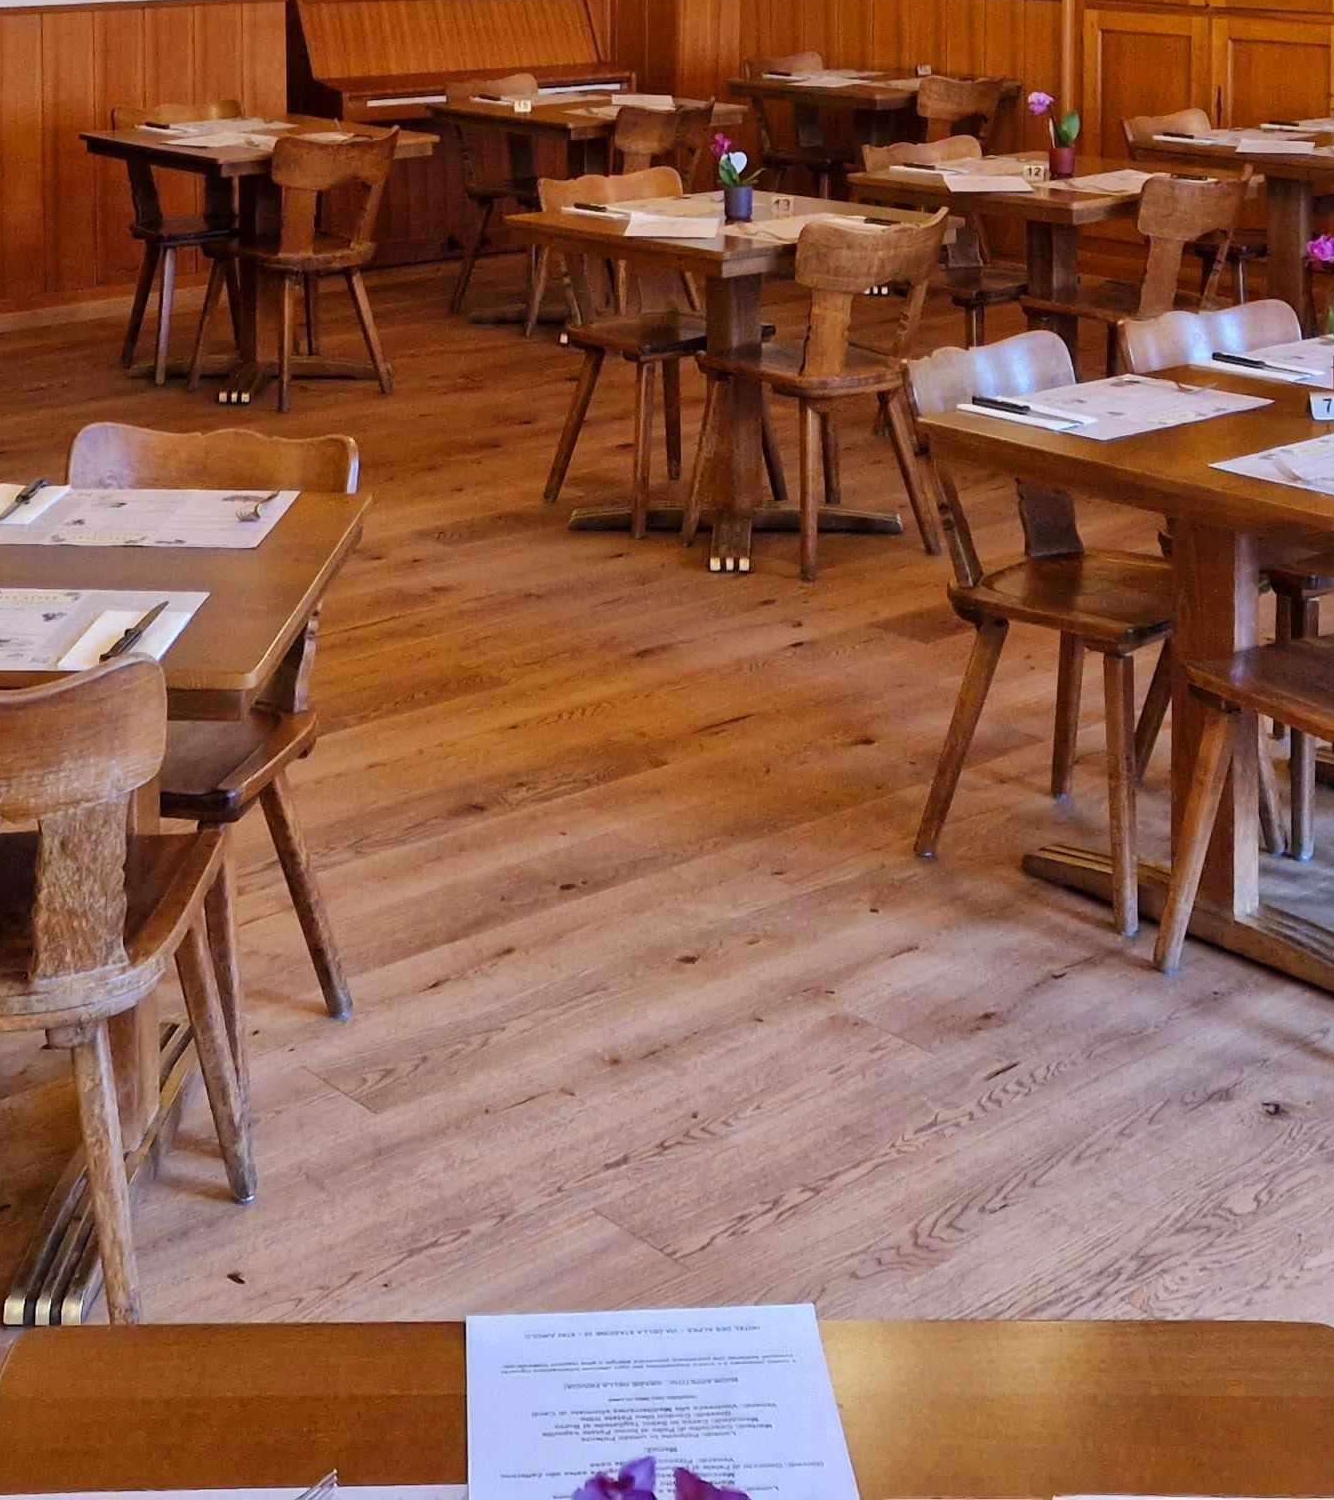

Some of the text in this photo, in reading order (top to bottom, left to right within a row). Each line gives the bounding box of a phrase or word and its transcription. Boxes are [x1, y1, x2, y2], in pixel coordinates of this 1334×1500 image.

[1027, 167, 1041, 177] 12
[774, 198, 791, 211] 13
[1323, 398, 1332, 412] 7
